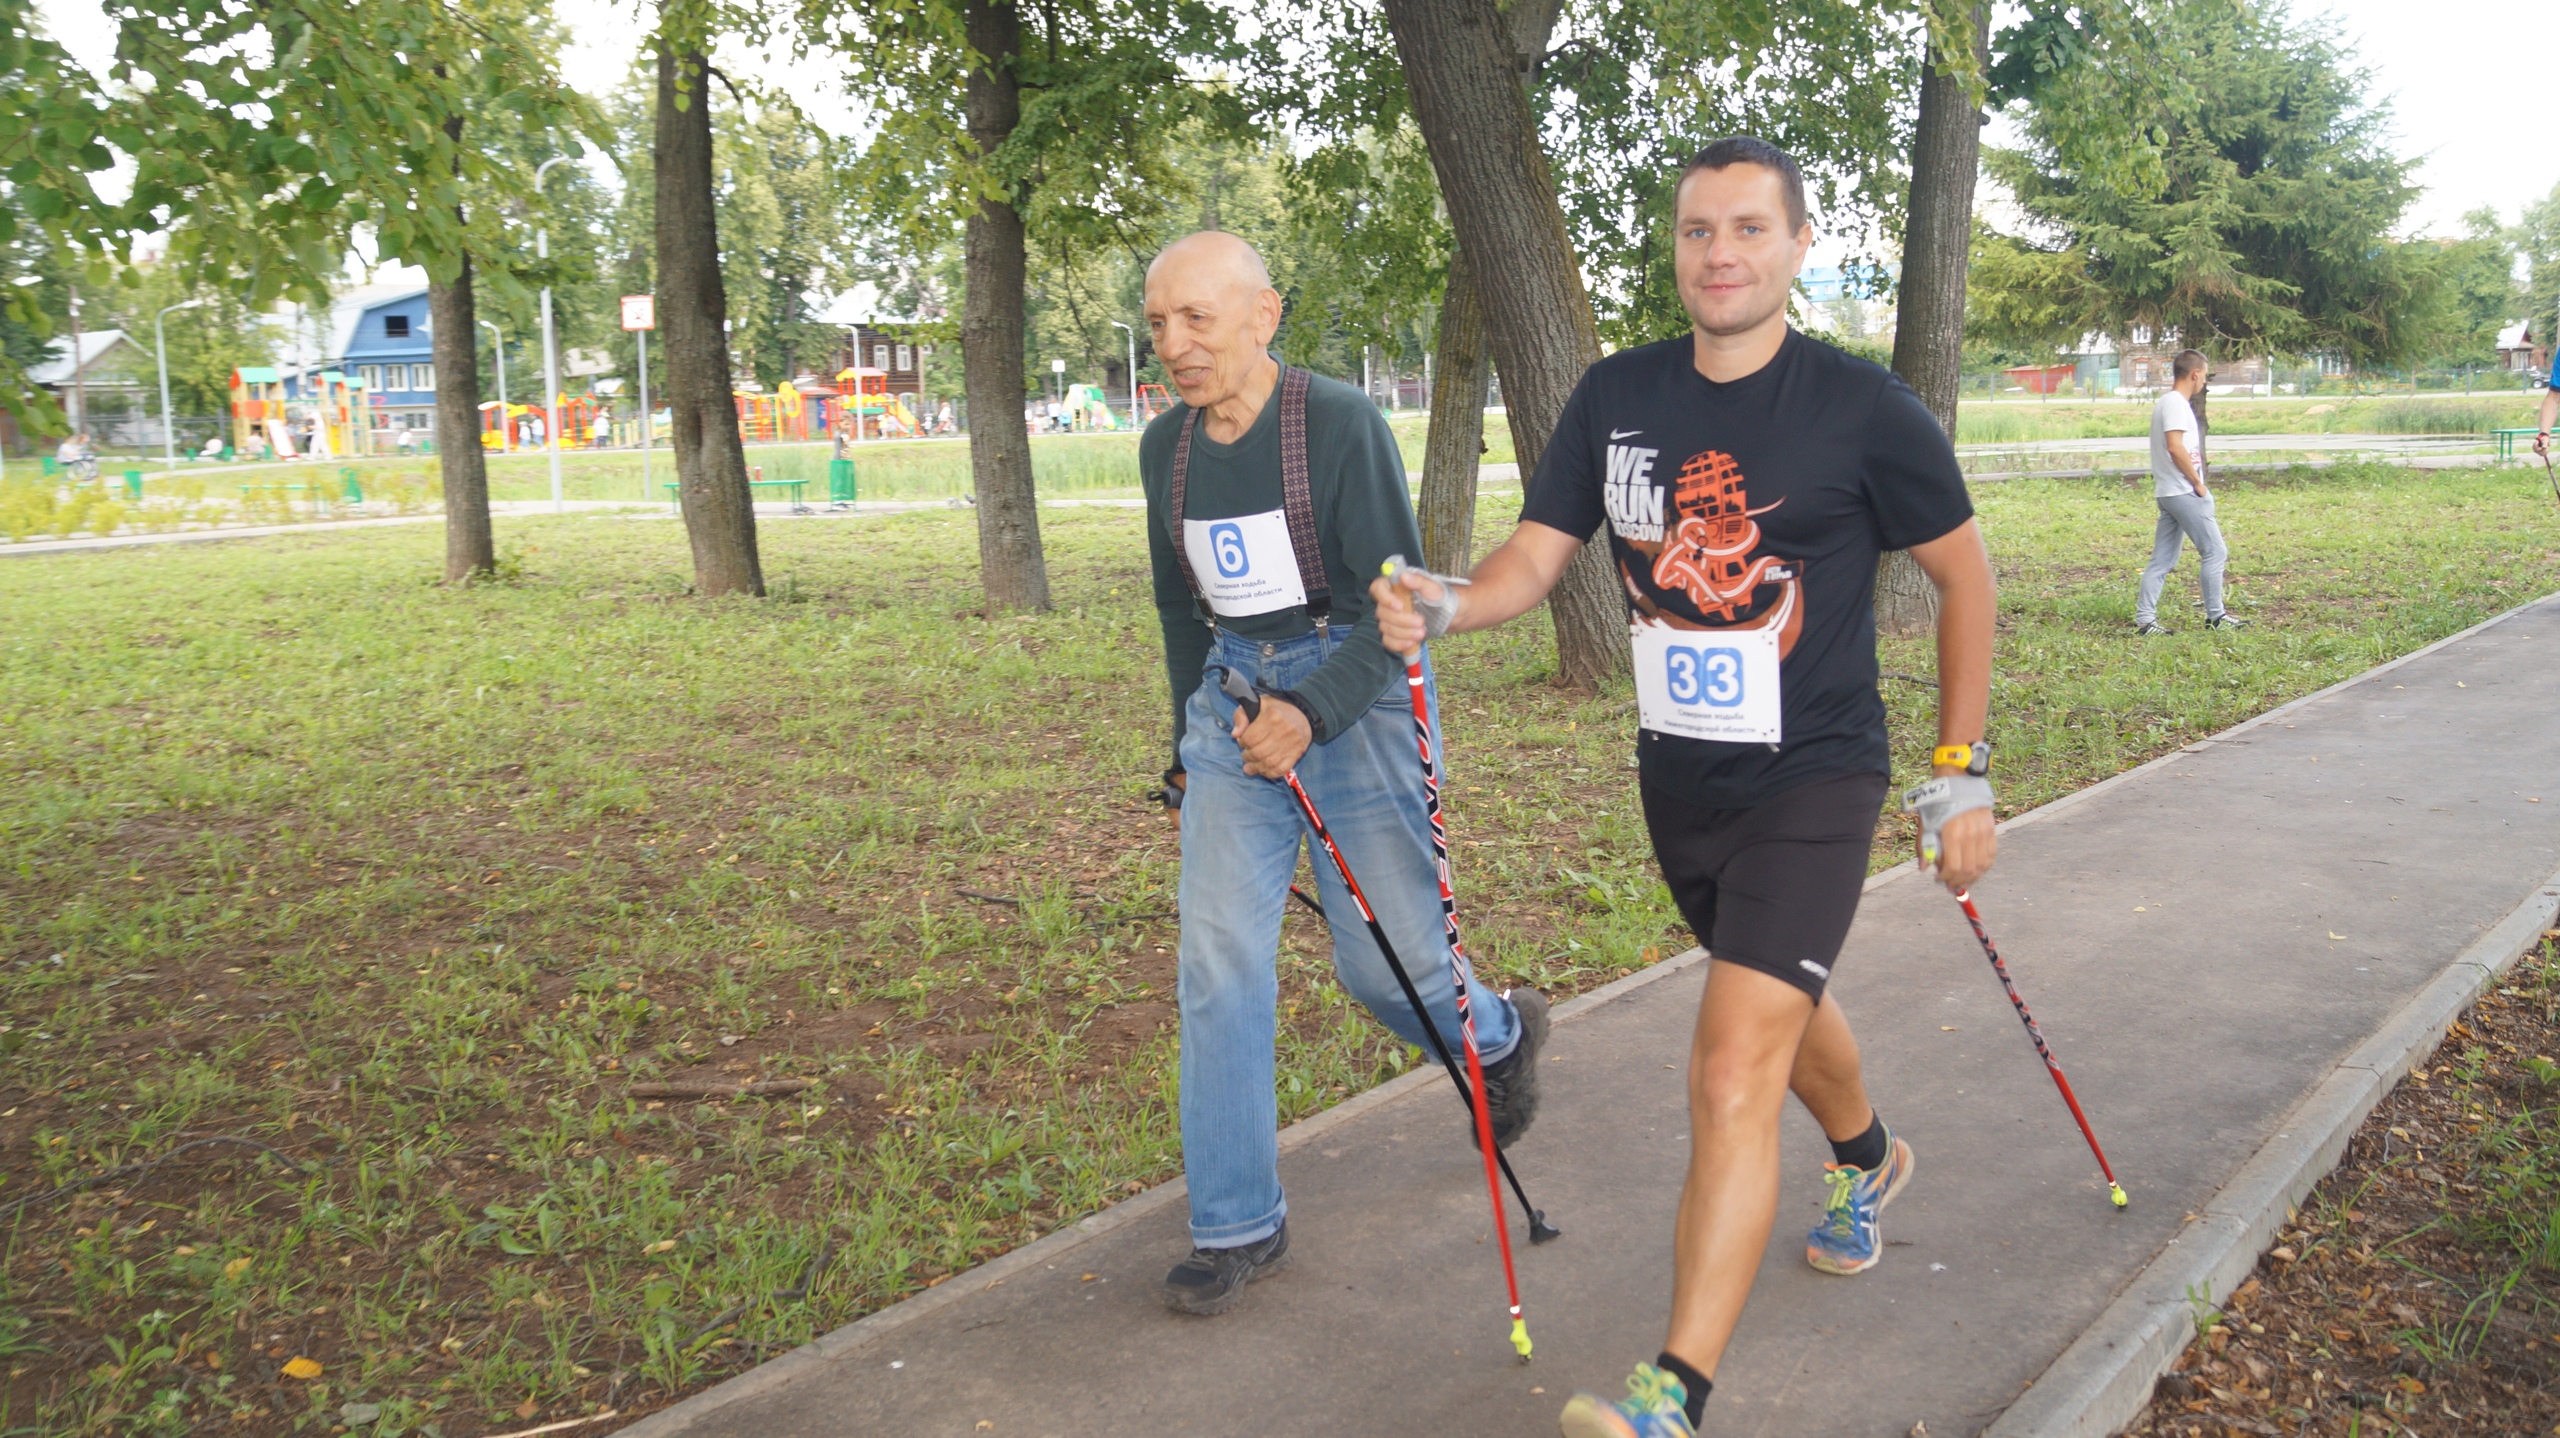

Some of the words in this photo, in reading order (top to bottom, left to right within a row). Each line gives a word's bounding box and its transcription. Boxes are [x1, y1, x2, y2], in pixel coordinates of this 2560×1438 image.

[1606, 444, 1659, 486] WE
[1604, 482, 1665, 525] RUN
[1216, 529, 1244, 573] 6
[1669, 652, 1741, 702] 33
